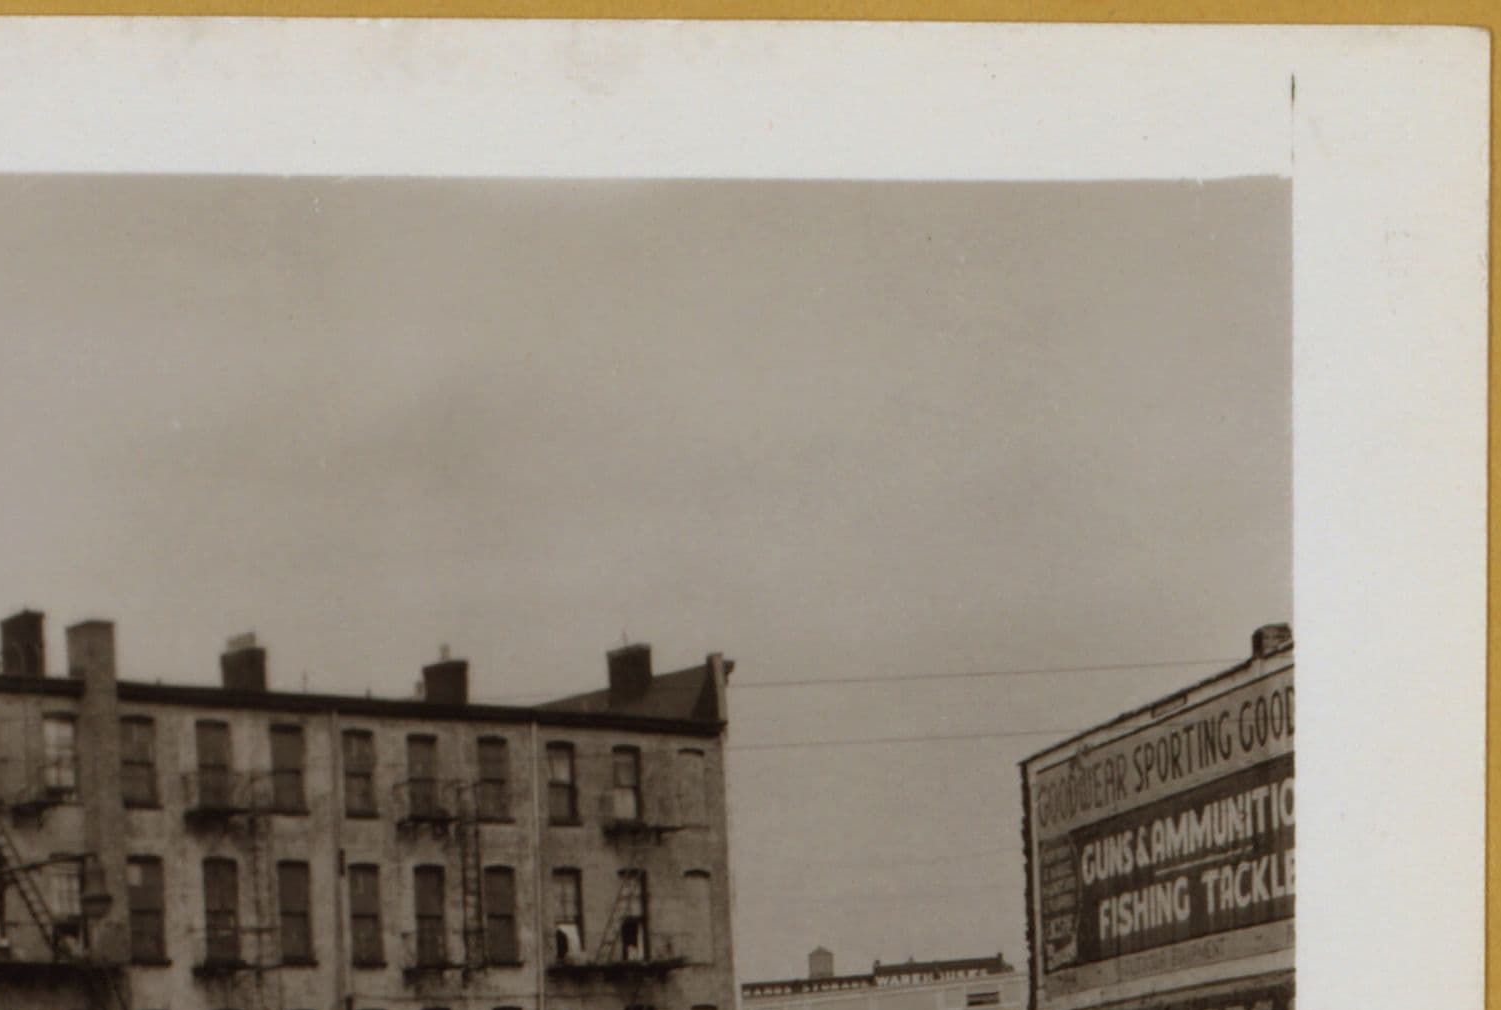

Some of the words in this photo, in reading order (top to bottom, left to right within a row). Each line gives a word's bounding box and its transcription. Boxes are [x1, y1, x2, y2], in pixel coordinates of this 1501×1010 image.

[1038, 754, 1128, 828] GOODWEAR
[1133, 711, 1233, 792] SPORTING
[1081, 830, 1134, 885] GUNS
[1136, 825, 1150, 868] &
[1100, 876, 1190, 940] FISHING
[1202, 848, 1295, 914] TACKLE
